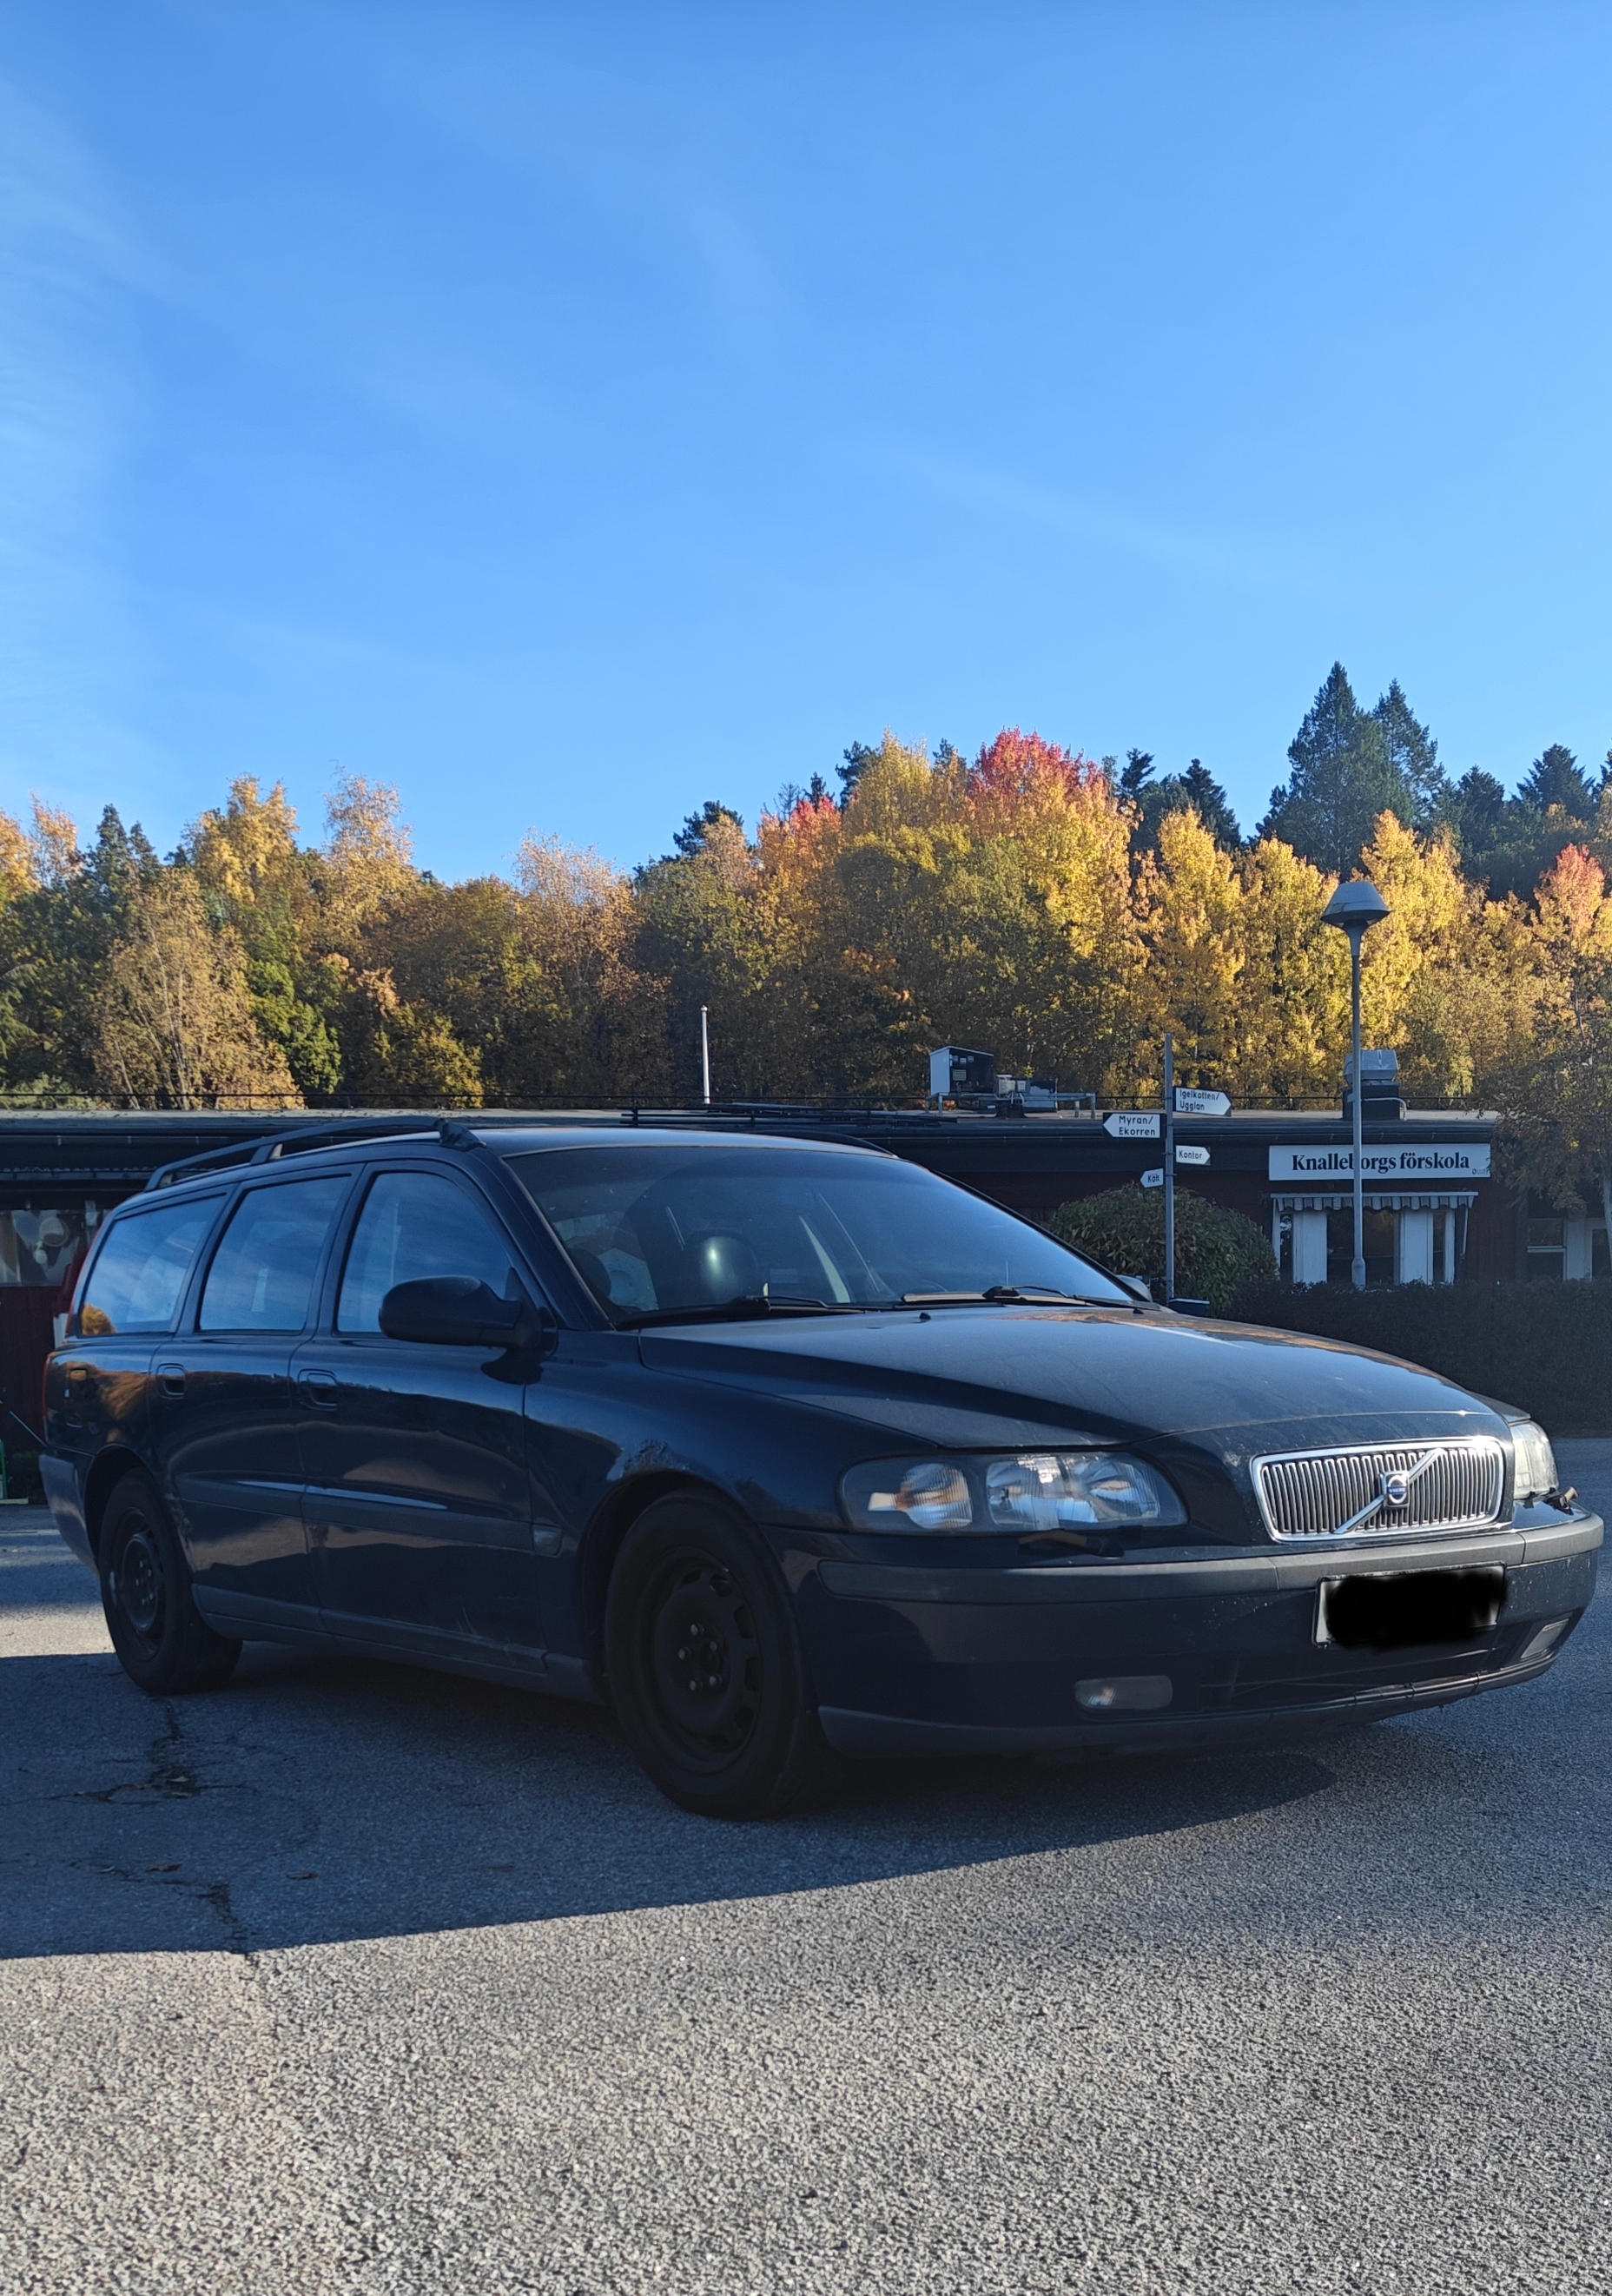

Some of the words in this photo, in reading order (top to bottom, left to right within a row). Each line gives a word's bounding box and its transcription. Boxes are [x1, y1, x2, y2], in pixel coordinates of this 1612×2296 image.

[1179, 1089, 1220, 1101] Igelkotten/
[1179, 1102, 1206, 1112] Ugglan
[1119, 1115, 1153, 1126] Myran/
[1119, 1127, 1156, 1135] Ekorren
[1179, 1150, 1203, 1160] Kontor
[1399, 1152, 1470, 1169] förskola
